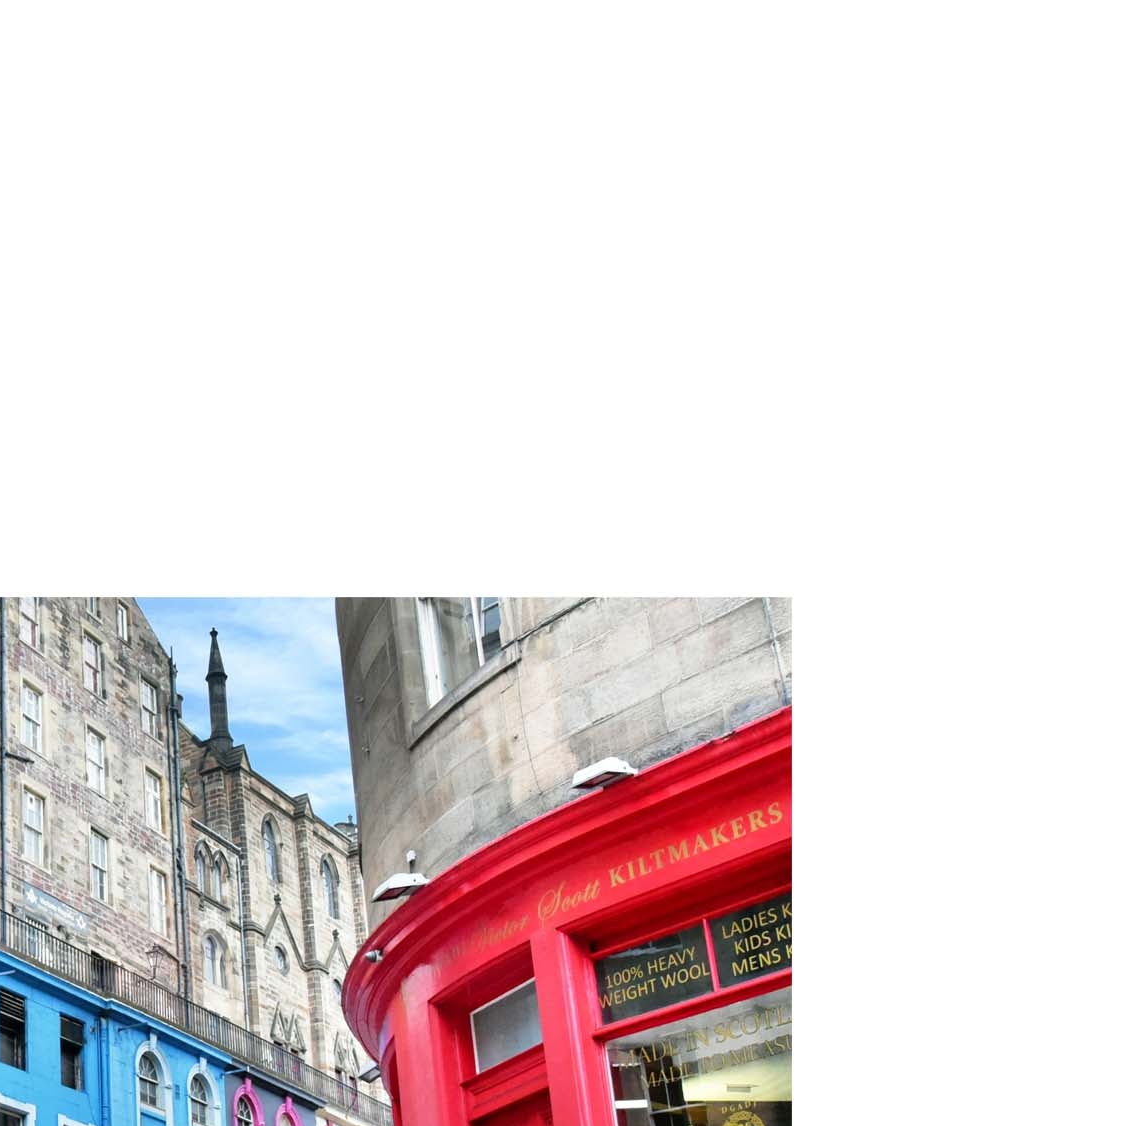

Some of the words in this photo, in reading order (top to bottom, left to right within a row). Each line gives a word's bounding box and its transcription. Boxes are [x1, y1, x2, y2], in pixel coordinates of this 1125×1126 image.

[537, 880, 603, 921] Scott
[608, 802, 784, 888] KILTMAKERS
[721, 907, 778, 940] LADIES
[734, 930, 772, 956] KIDS
[605, 965, 644, 989] 100%
[647, 946, 696, 975] HEAVY
[731, 948, 781, 977] MENS
[599, 978, 657, 1009] WEIGHT
[660, 962, 710, 989] WOOL
